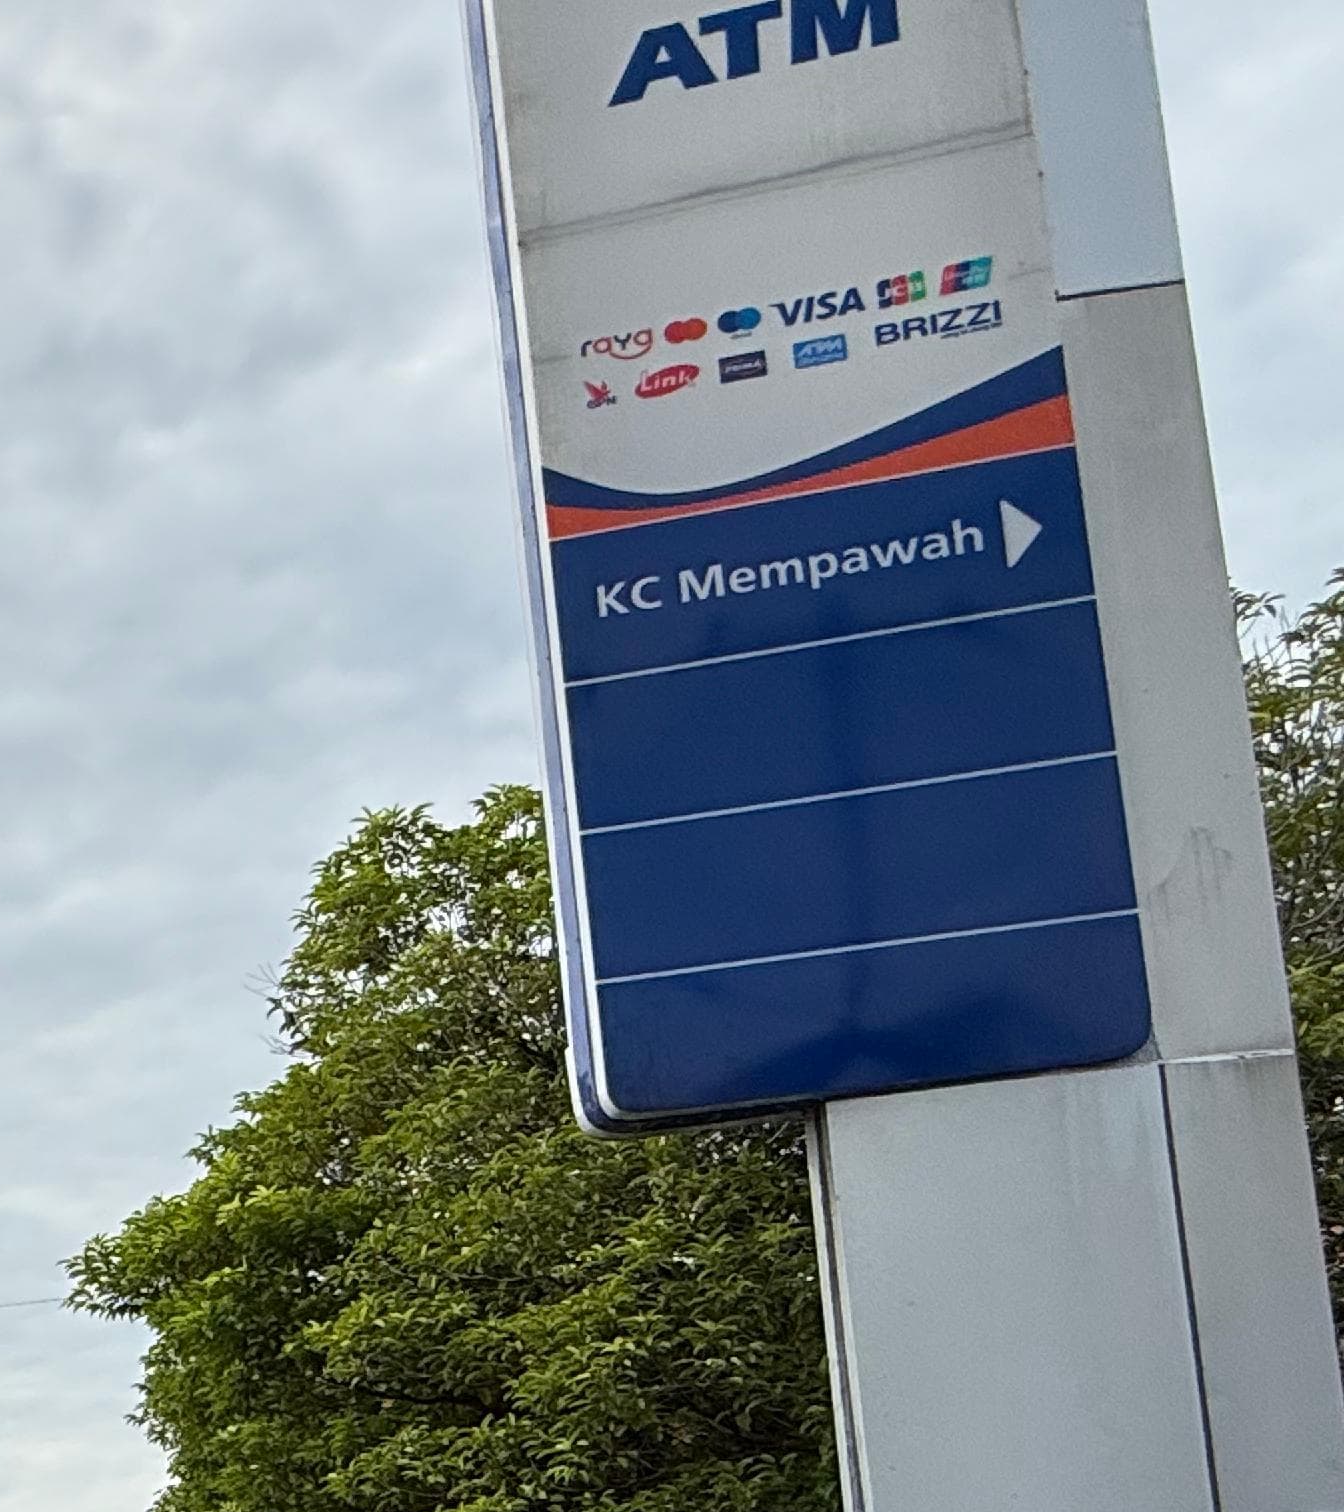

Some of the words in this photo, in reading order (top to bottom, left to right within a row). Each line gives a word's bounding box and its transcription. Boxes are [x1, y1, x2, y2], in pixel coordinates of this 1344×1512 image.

[608, 0, 901, 107] ATM
[769, 287, 866, 327] VISA
[874, 299, 1003, 347] BRIZZI
[640, 366, 695, 393] Link
[595, 576, 663, 618] KC
[678, 518, 985, 604] Mempawah
